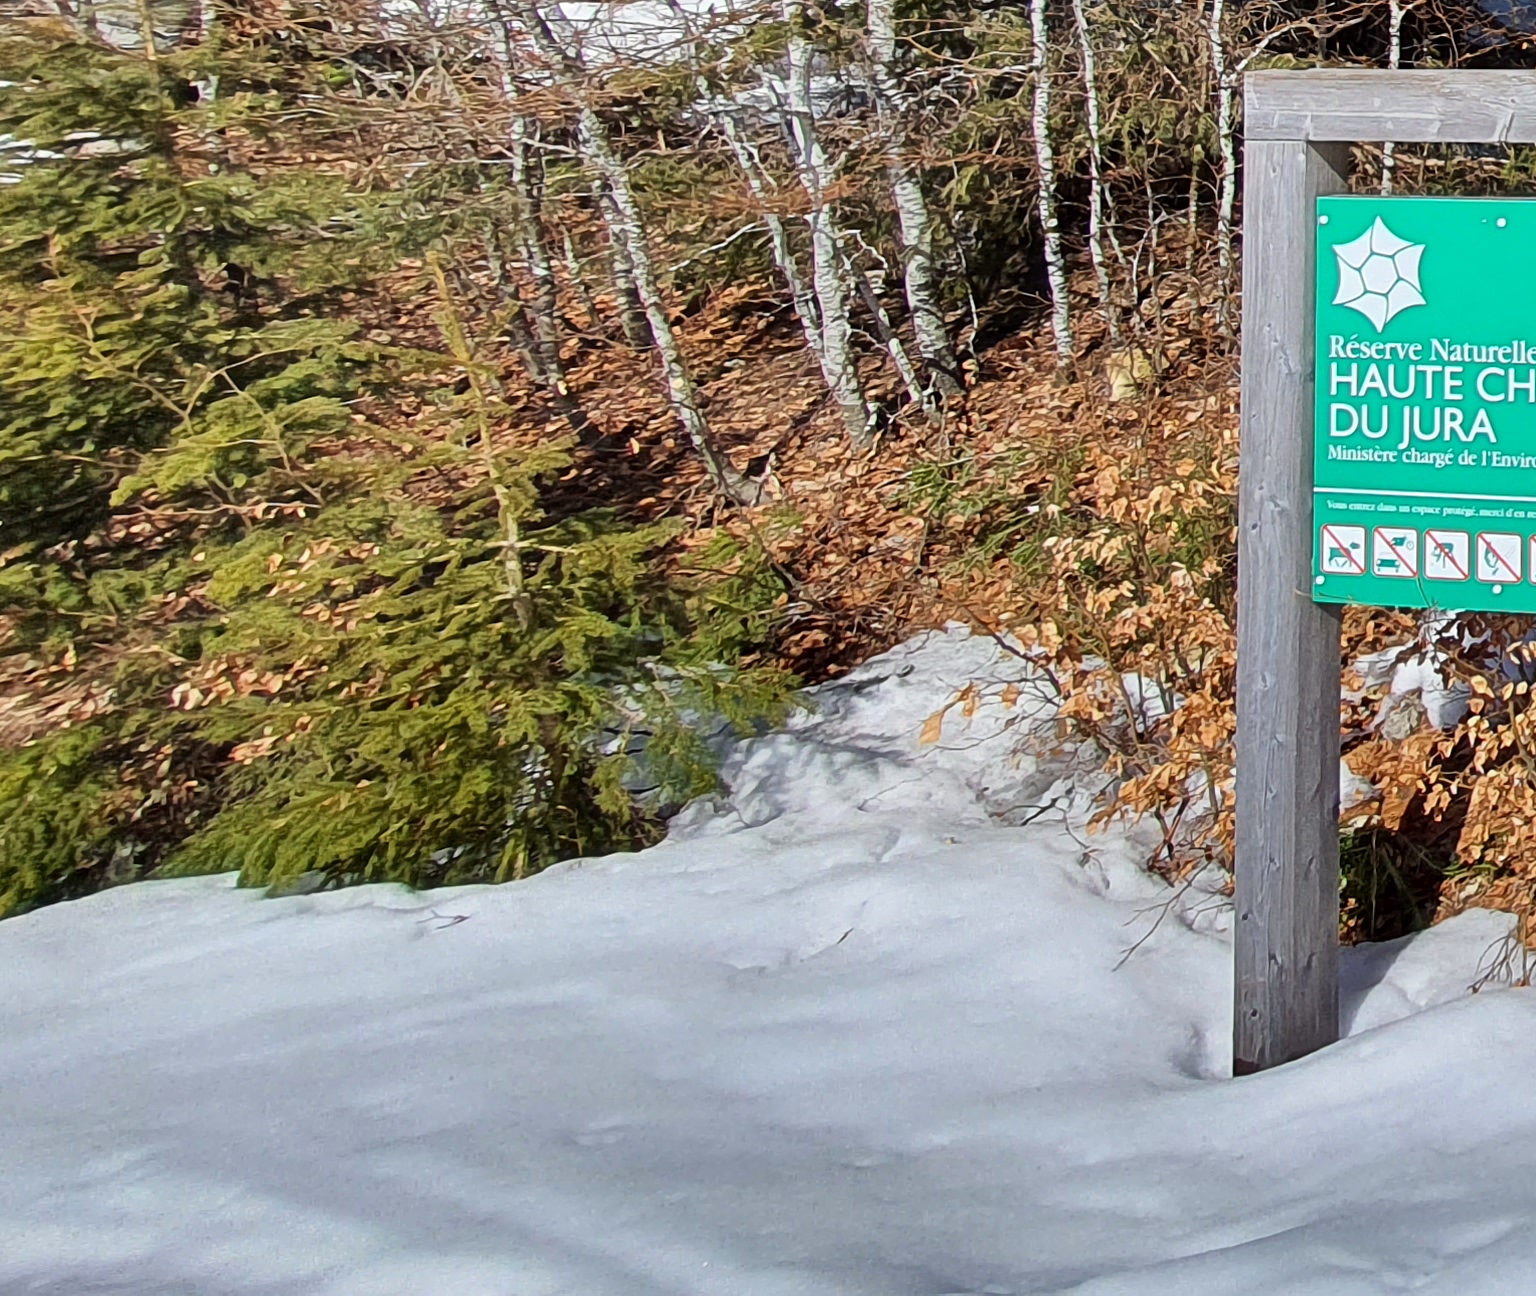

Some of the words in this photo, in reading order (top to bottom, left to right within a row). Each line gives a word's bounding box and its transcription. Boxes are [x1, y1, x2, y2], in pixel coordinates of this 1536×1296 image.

[1328, 334, 1422, 361] Réserve
[1329, 362, 1464, 400] HAUTE
[1329, 402, 1389, 439] DU
[1397, 405, 1498, 450] JURA
[1328, 444, 1398, 463] Ministère
[1401, 447, 1454, 469] chargé
[1458, 450, 1477, 466] de
